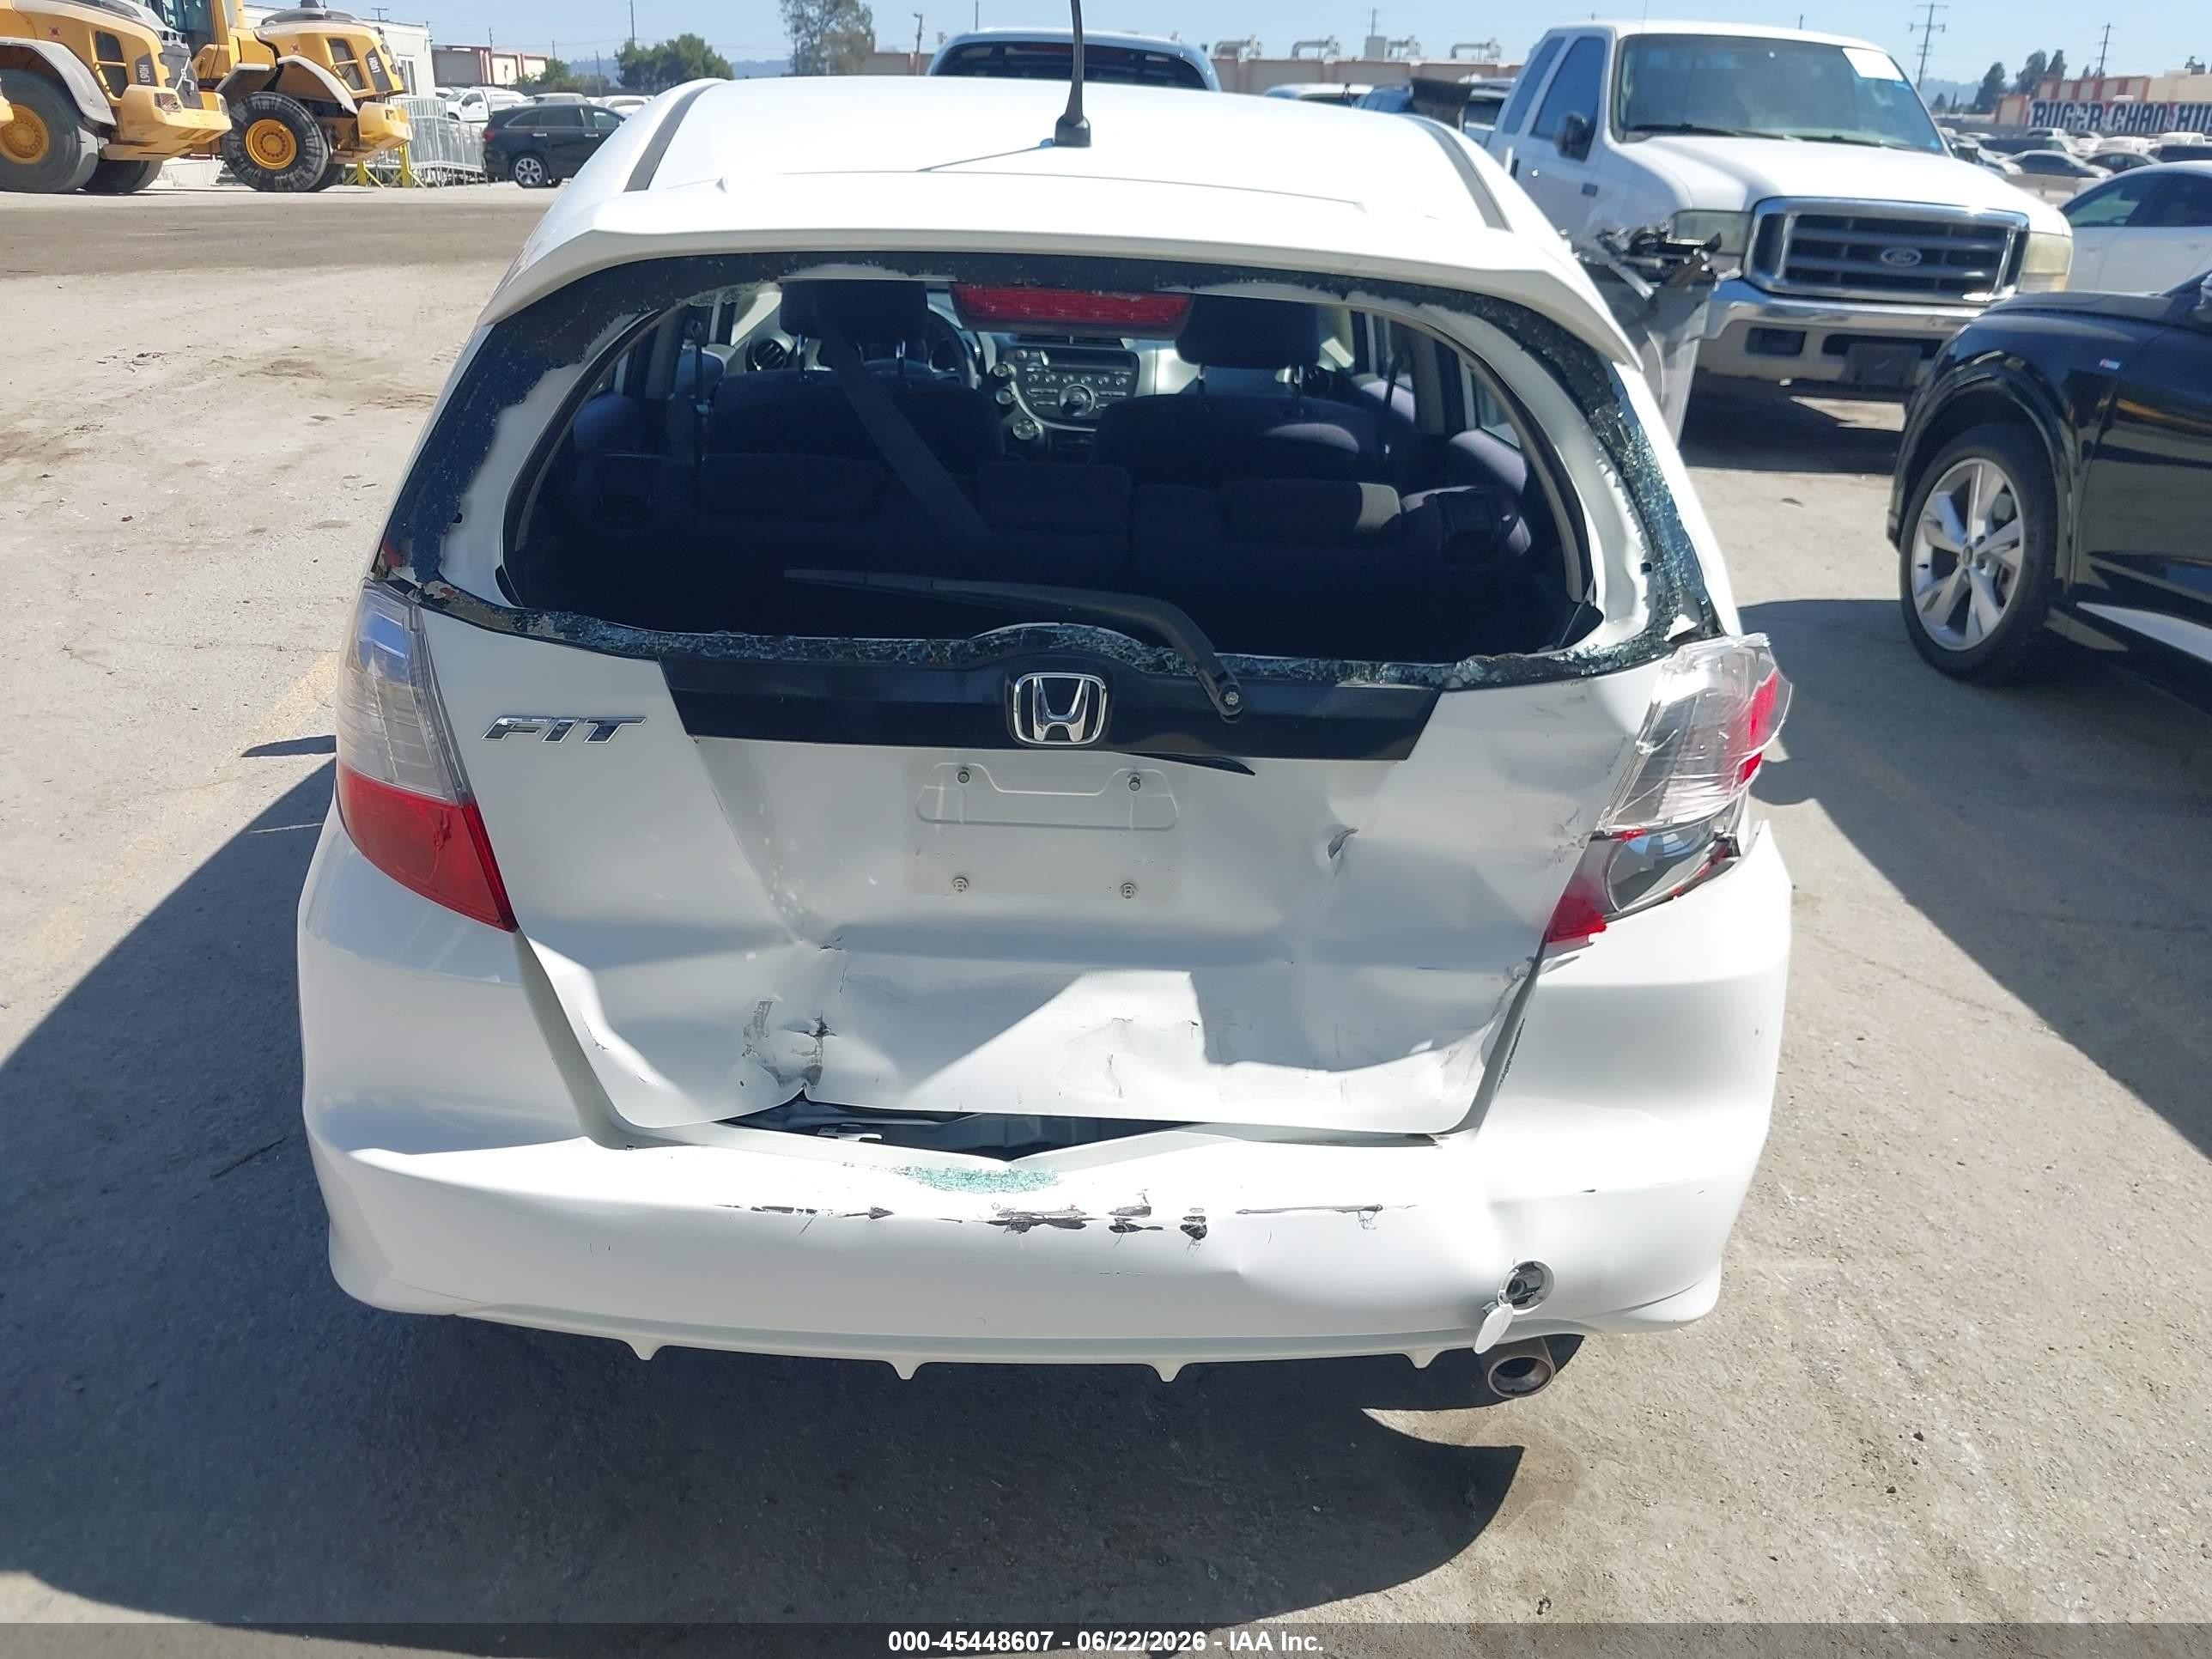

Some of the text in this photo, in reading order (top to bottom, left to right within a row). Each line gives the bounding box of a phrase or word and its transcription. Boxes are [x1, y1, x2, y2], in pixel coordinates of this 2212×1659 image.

[138, 64, 151, 83] L90H
[368, 57, 381, 74] L90H
[481, 714, 647, 744] FIT
